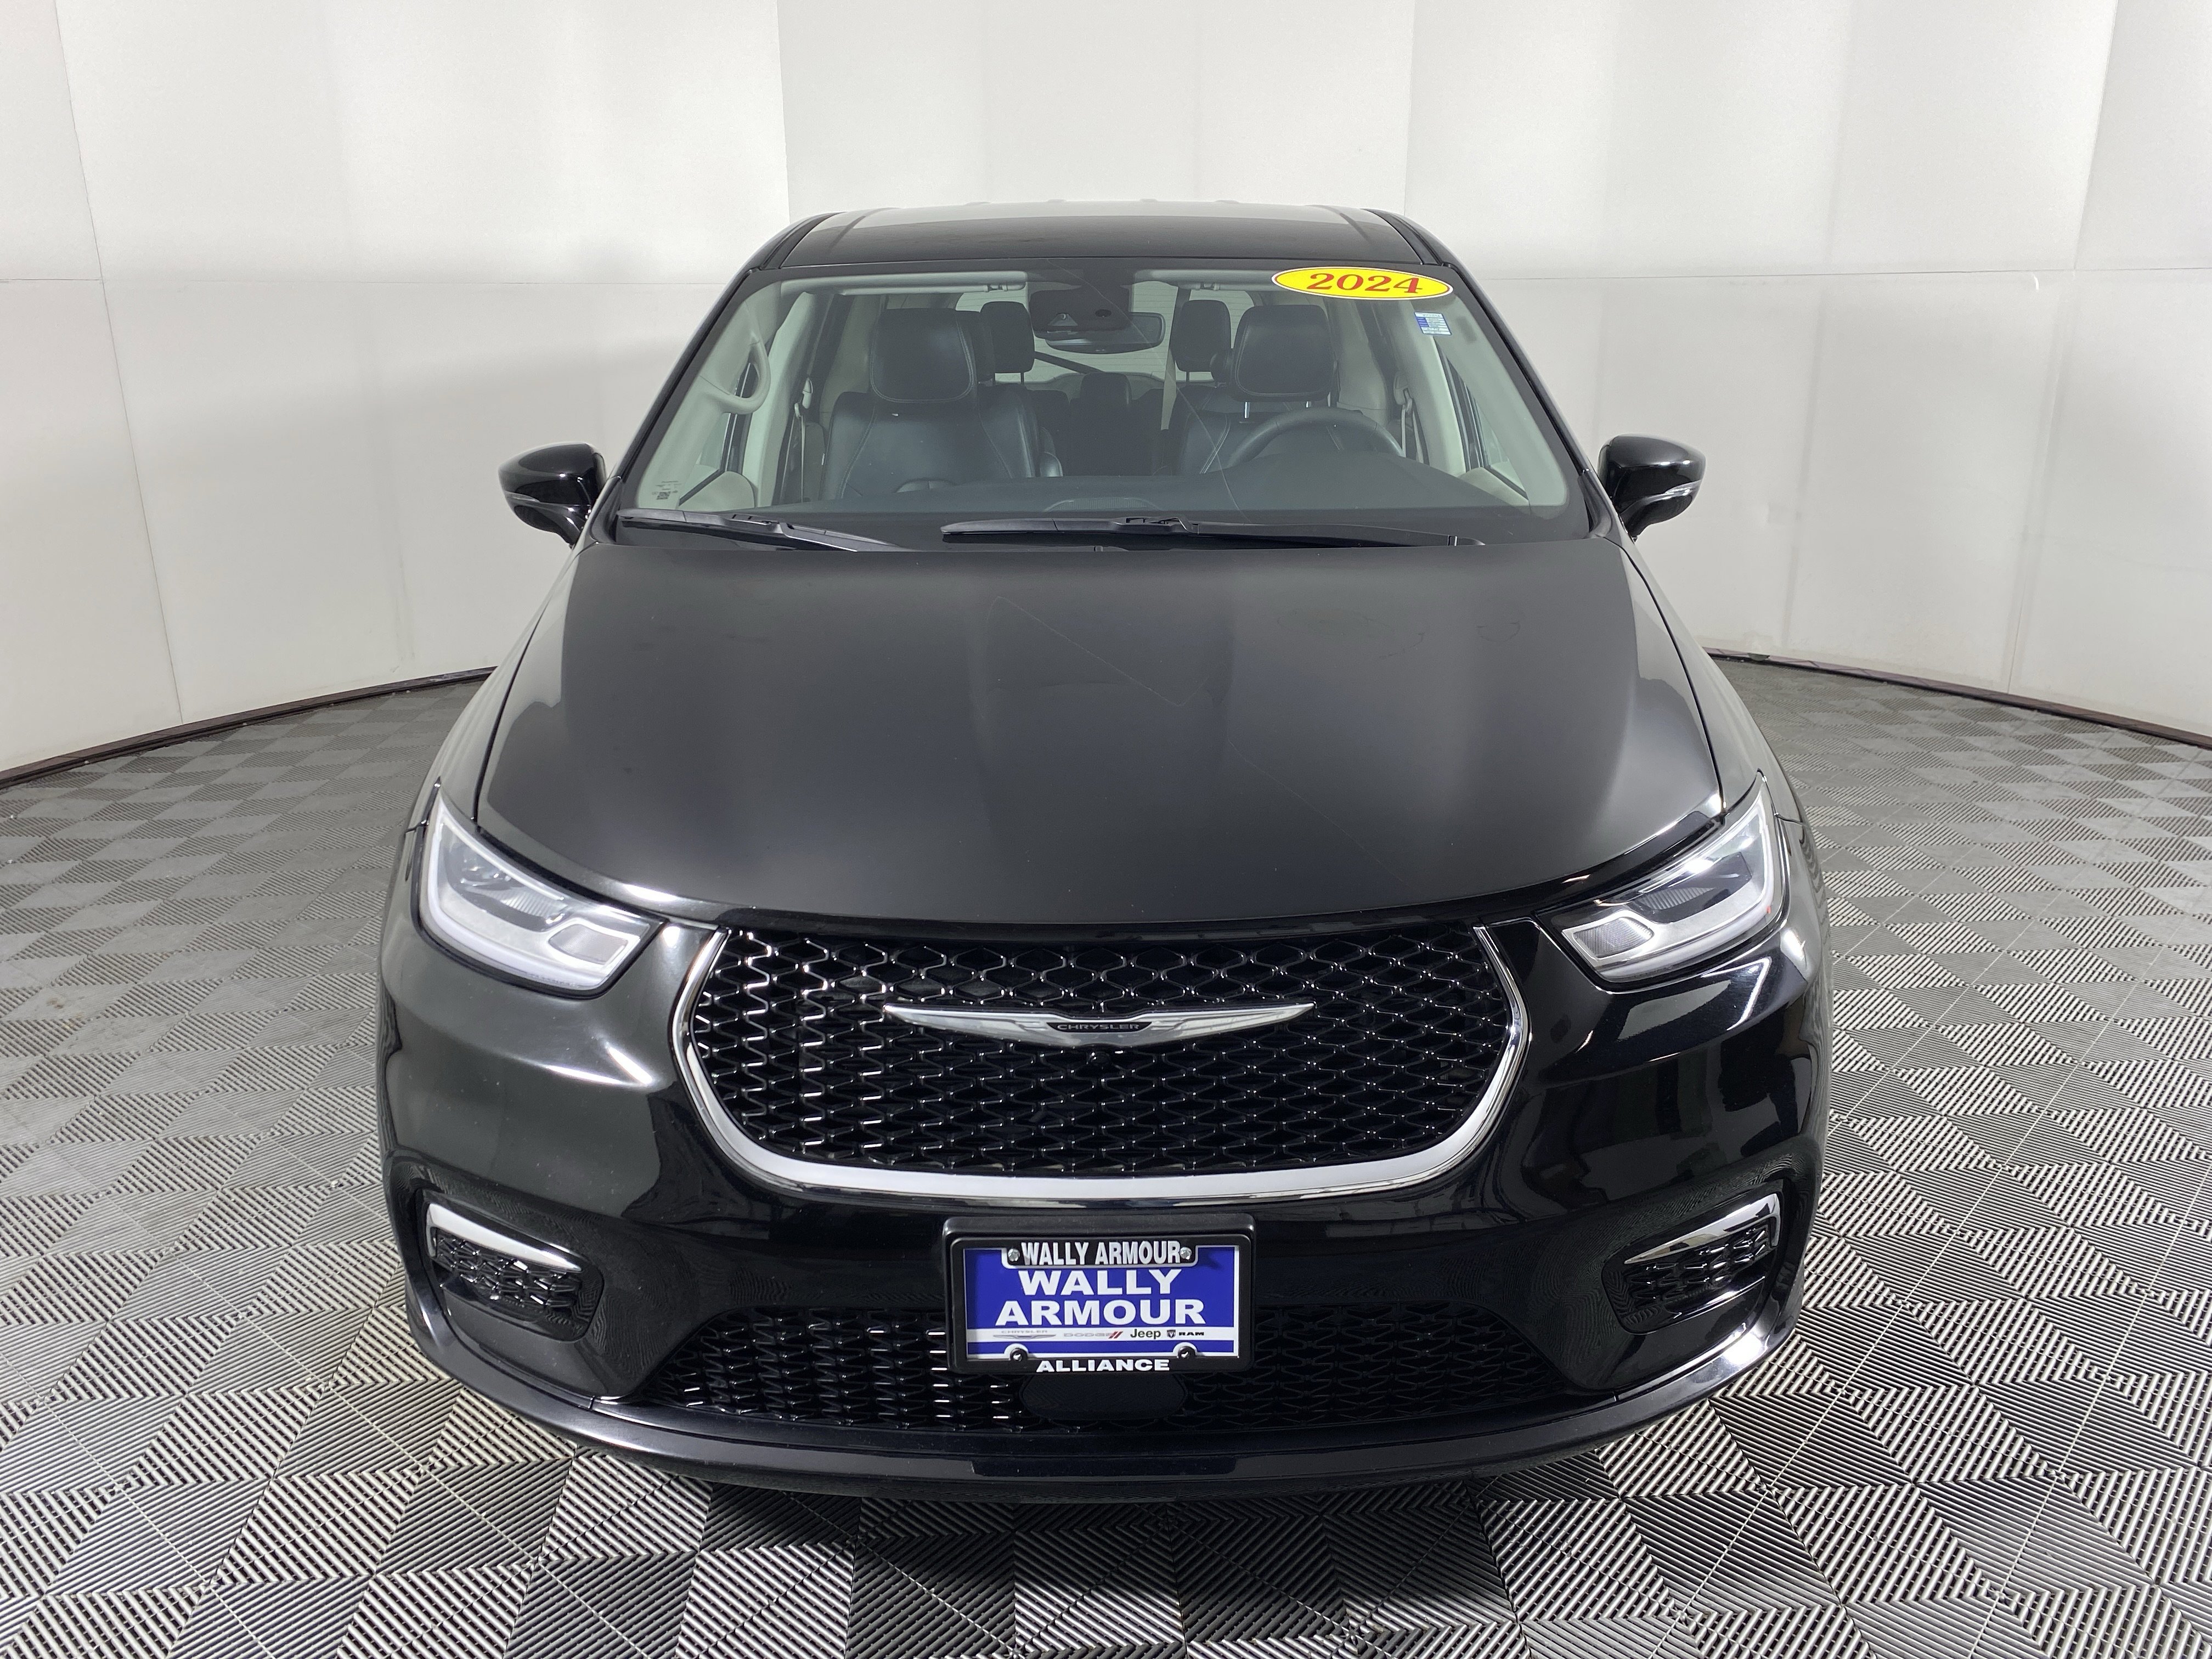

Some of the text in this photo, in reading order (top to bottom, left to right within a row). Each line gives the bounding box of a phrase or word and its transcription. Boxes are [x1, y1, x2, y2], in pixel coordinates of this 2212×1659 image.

[1306, 273, 1423, 294] 2024
[1021, 1240, 1181, 1266] WALLY ARMOUR
[1018, 1269, 1182, 1296] WALLY
[995, 1299, 1206, 1326] ARMOUR
[1130, 1329, 1161, 1340] Jeep
[1036, 1359, 1170, 1373] ALLIANCE
